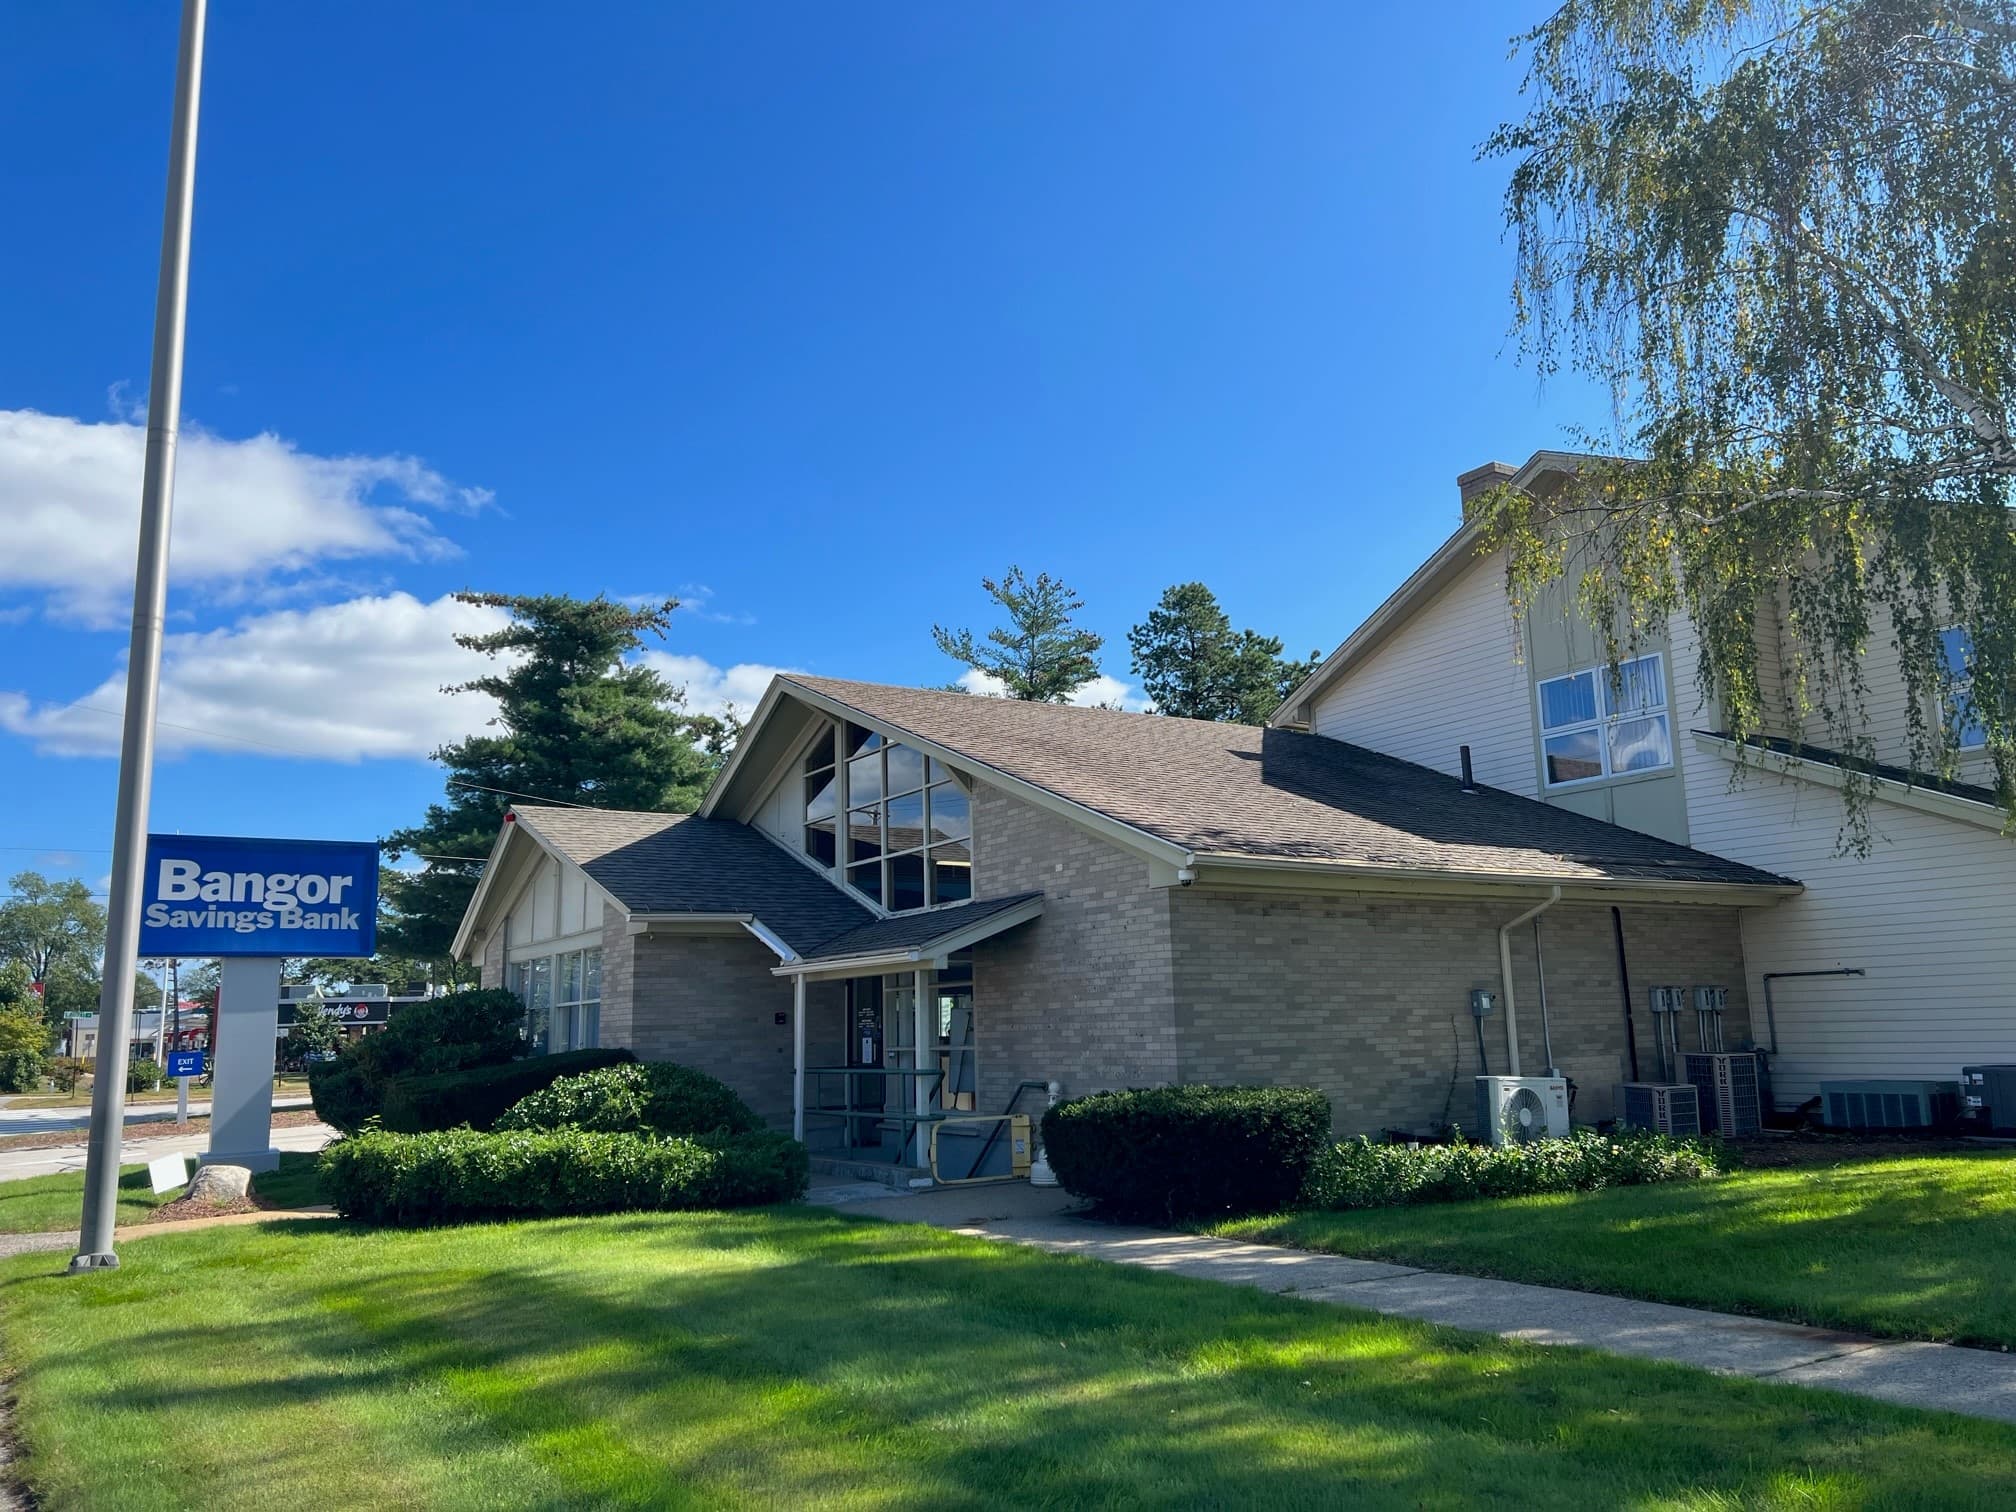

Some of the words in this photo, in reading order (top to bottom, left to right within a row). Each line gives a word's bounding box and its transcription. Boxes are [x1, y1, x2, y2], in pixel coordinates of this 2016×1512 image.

[157, 858, 353, 911] Bangor
[145, 903, 274, 933] Savings
[279, 906, 361, 930] Bank
[177, 1057, 194, 1066] EXIT
